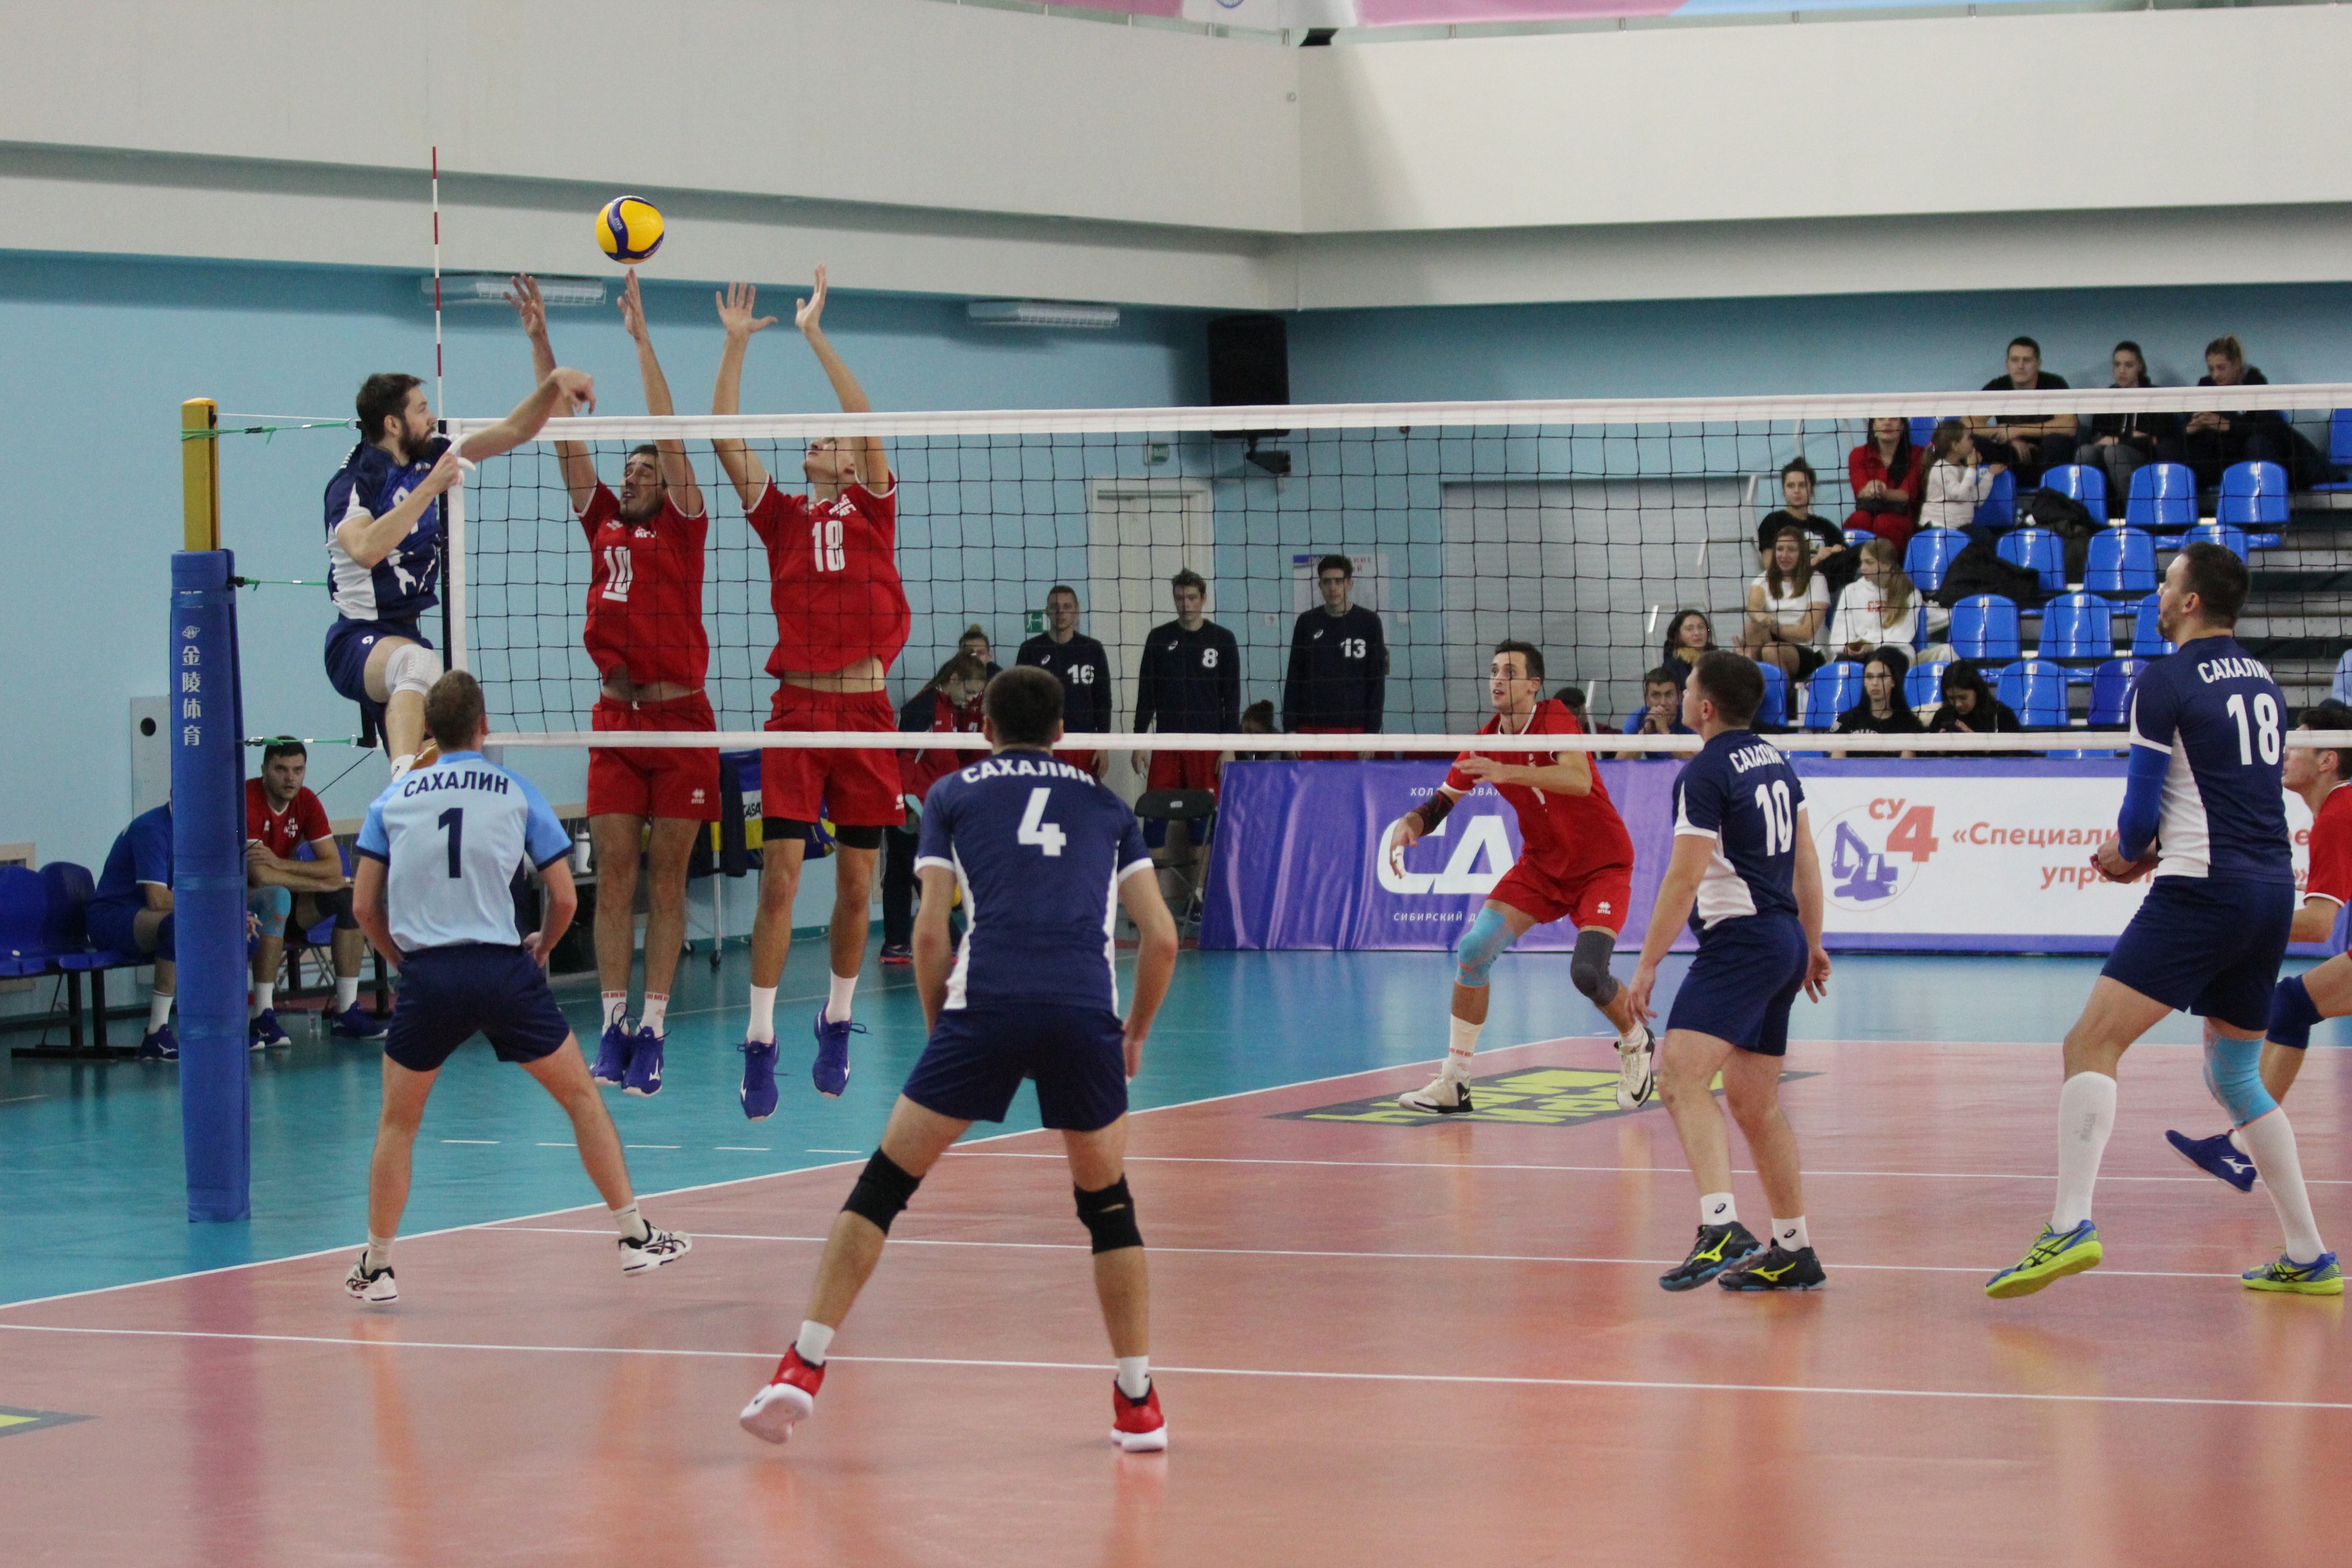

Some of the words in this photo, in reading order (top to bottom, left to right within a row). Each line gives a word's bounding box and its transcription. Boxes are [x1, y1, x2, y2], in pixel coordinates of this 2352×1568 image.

[603, 546, 634, 595] 10
[812, 520, 846, 572] 18
[1202, 648, 1218, 668] 8
[1341, 638, 1366, 658] 13
[181, 645, 202, 746] 金陵体育
[1068, 664, 1095, 685] 16
[2226, 693, 2280, 766] 18
[404, 771, 509, 797] САХАЛИН
[961, 759, 1096, 786] САХАЛИН
[1018, 788, 1066, 857] 4
[1755, 780, 1793, 857] 10
[1869, 797, 1906, 820] СУ
[438, 808, 463, 878] 1
[1886, 806, 1939, 862] 4
[1394, 911, 1463, 922] СИБИРСКИЙ
